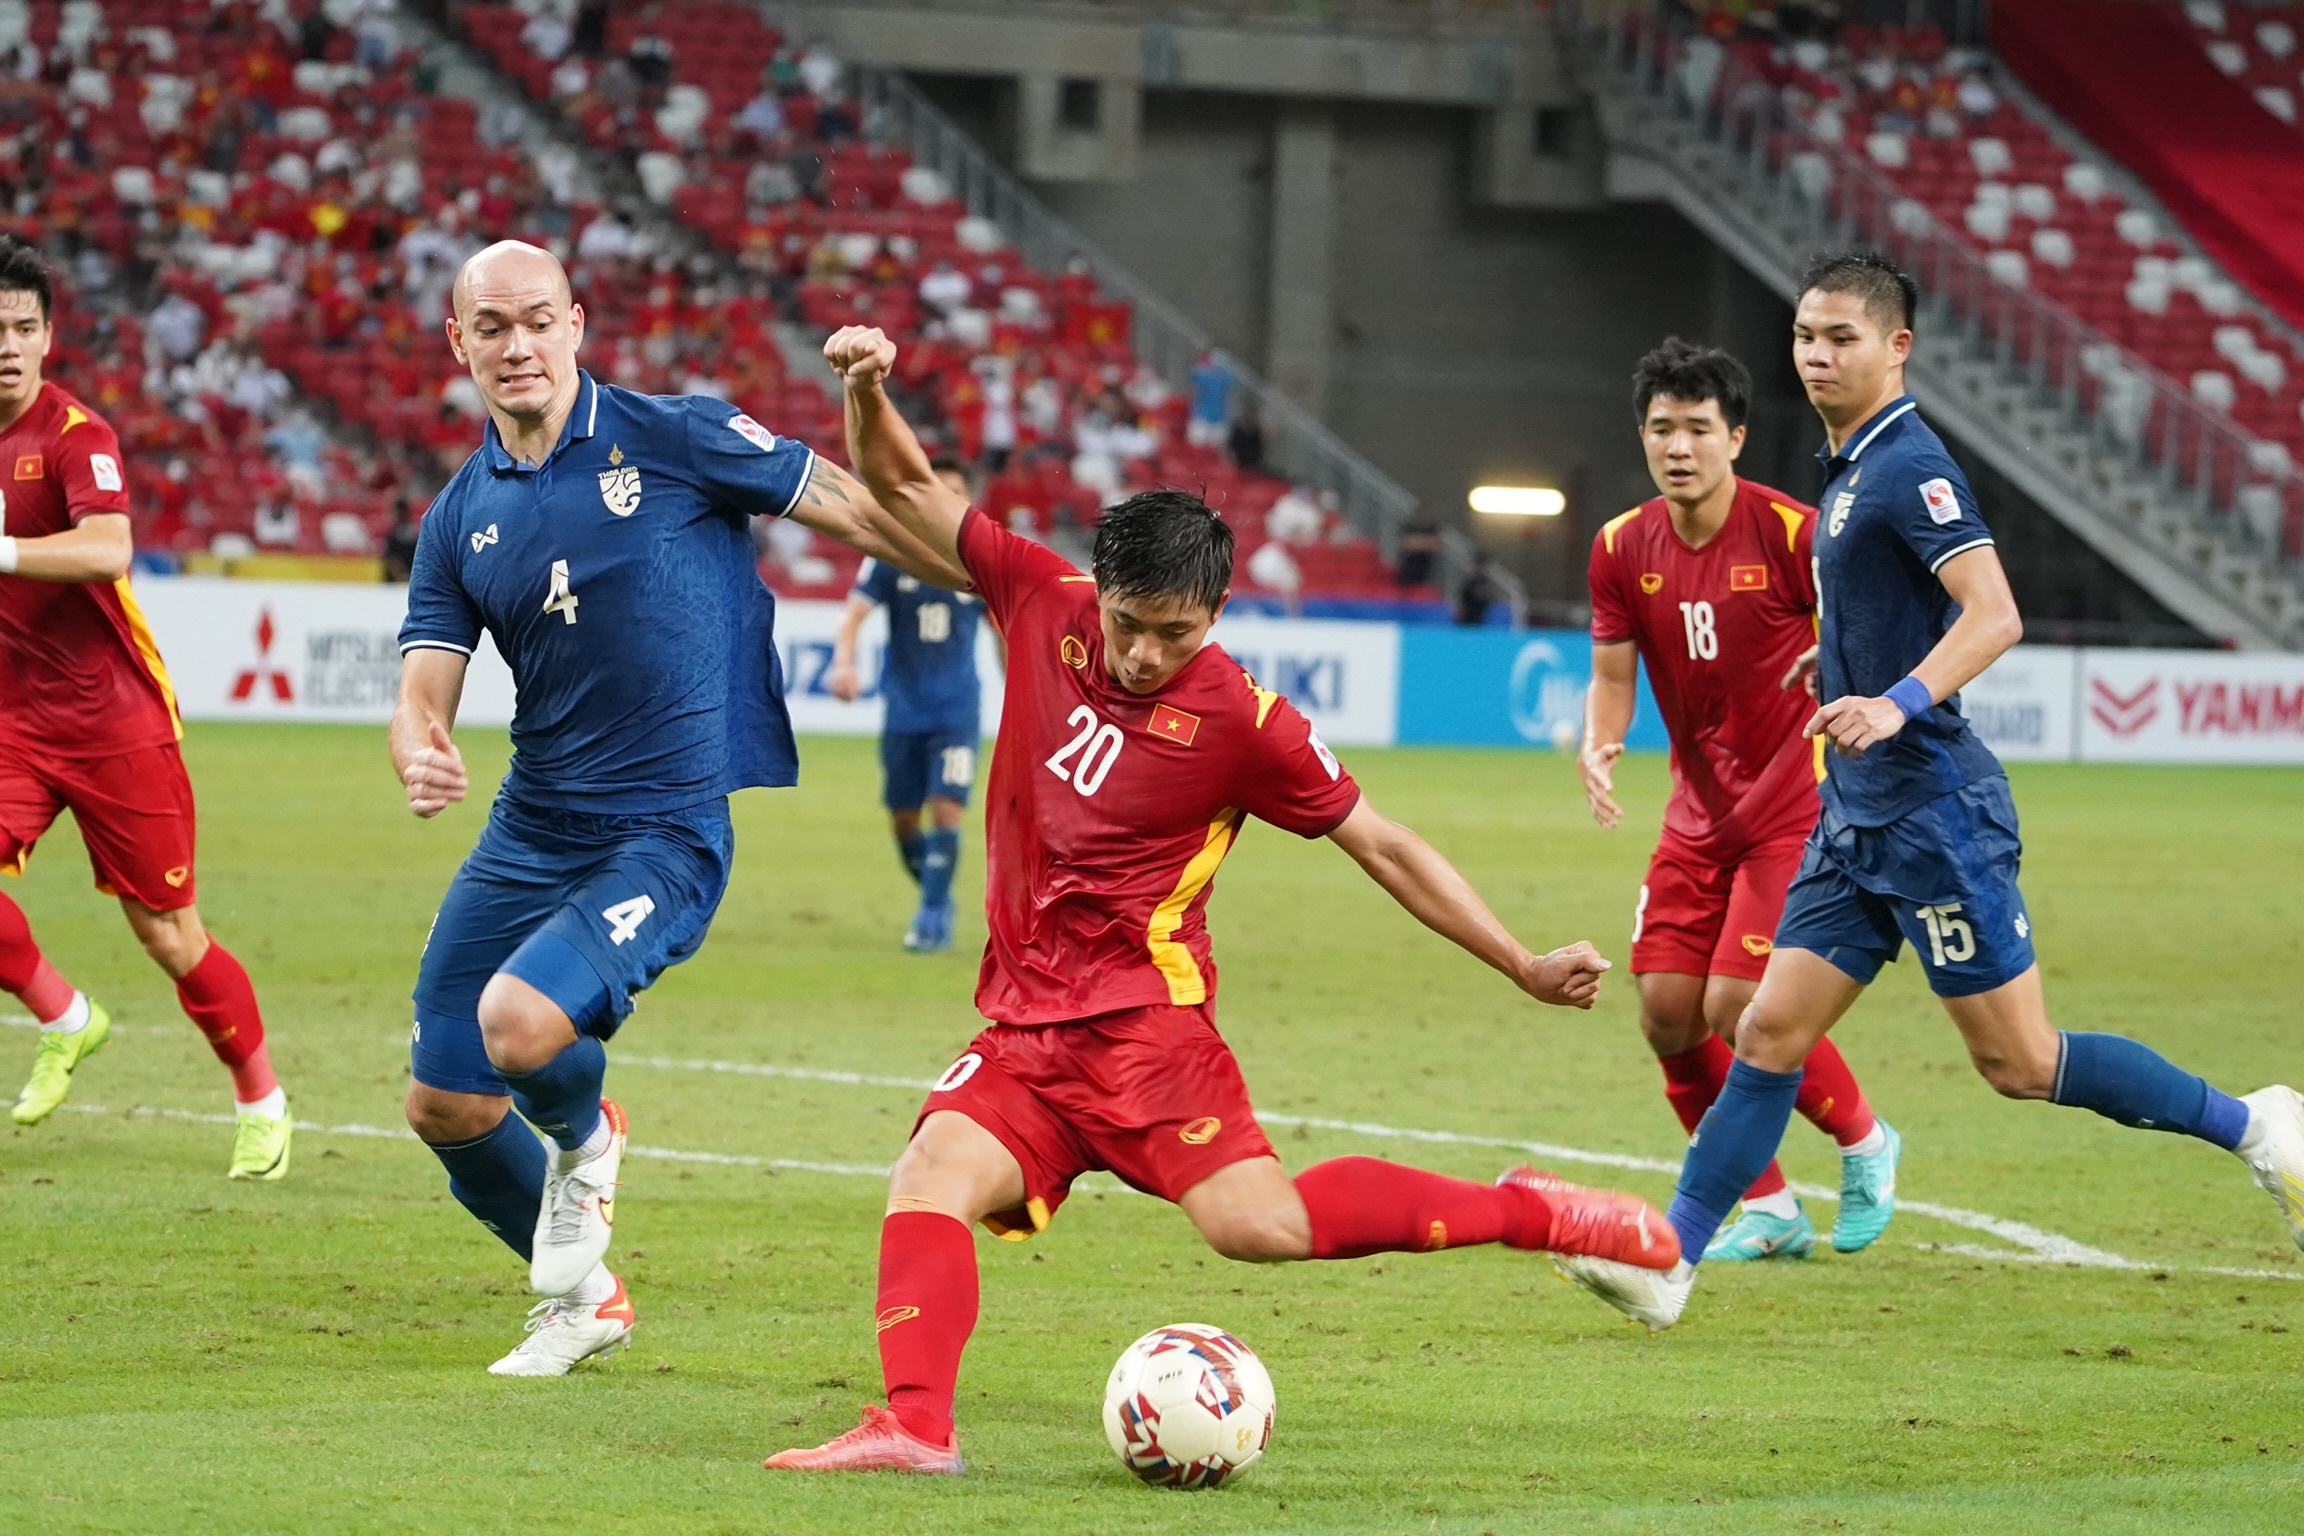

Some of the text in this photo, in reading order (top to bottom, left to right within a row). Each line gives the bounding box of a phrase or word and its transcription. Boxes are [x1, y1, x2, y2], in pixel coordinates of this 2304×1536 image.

[543, 559, 579, 625] 4
[917, 602, 951, 642] 18
[1679, 600, 1719, 661] 18
[941, 746, 975, 787] 18
[1045, 704, 1124, 797] 20
[602, 894, 656, 947] 4
[1916, 902, 1976, 967] 15
